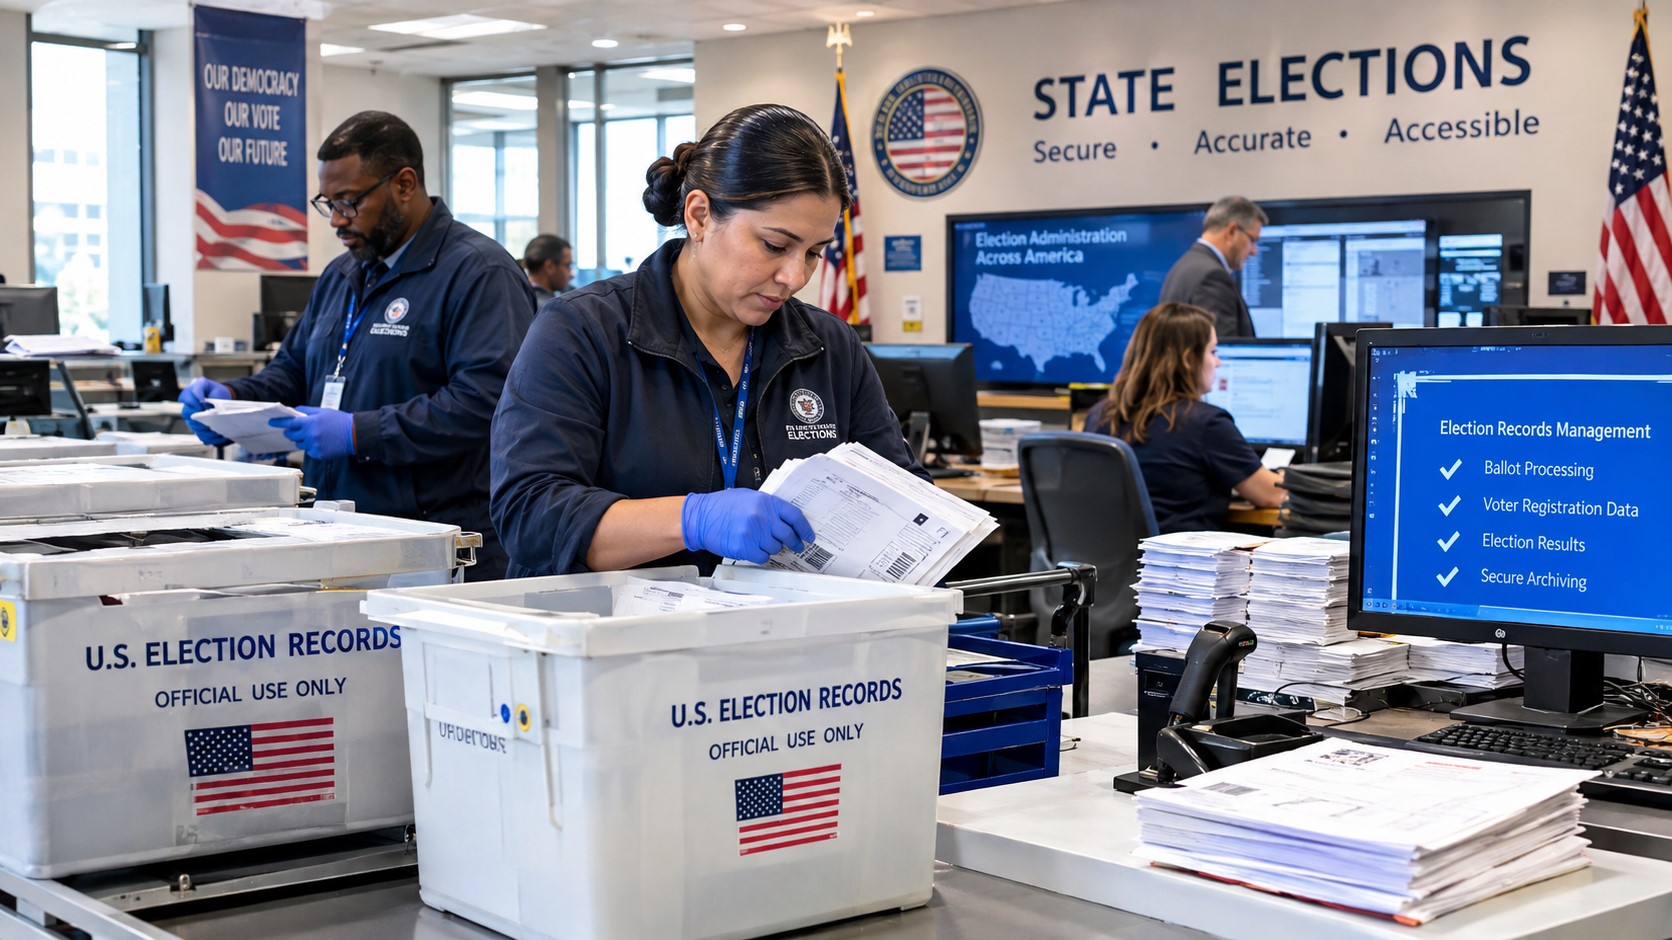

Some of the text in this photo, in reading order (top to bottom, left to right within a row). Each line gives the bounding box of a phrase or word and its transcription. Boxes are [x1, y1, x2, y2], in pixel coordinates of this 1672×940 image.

[204, 63, 299, 97] OUR DEMOCRACY
[1033, 35, 1531, 120] STATE ELECTIONS
[224, 101, 281, 131] OUR VOTE
[1034, 108, 1540, 163] Secure Accurate Accessible
[218, 137, 288, 167] OUR FUTURE
[975, 227, 1127, 247] Election Administration
[975, 247, 1084, 265] Across America
[787, 429, 837, 440] ELECTIONS
[1440, 420, 1651, 442] Election Records Management
[1484, 460, 1595, 481] Ballot Processing
[1483, 496, 1639, 518] Voter Registration Data
[1482, 532, 1586, 552] Election Results
[1481, 568, 1587, 593] Secure Archiving
[85, 625, 401, 671] U.S. ELECTION RECORDS
[154, 677, 347, 708] OFFICIAL USE ONLY
[671, 677, 903, 728] U.S. ELECTION RECORDS
[709, 722, 864, 760] OFFICIAL USE ONLY
